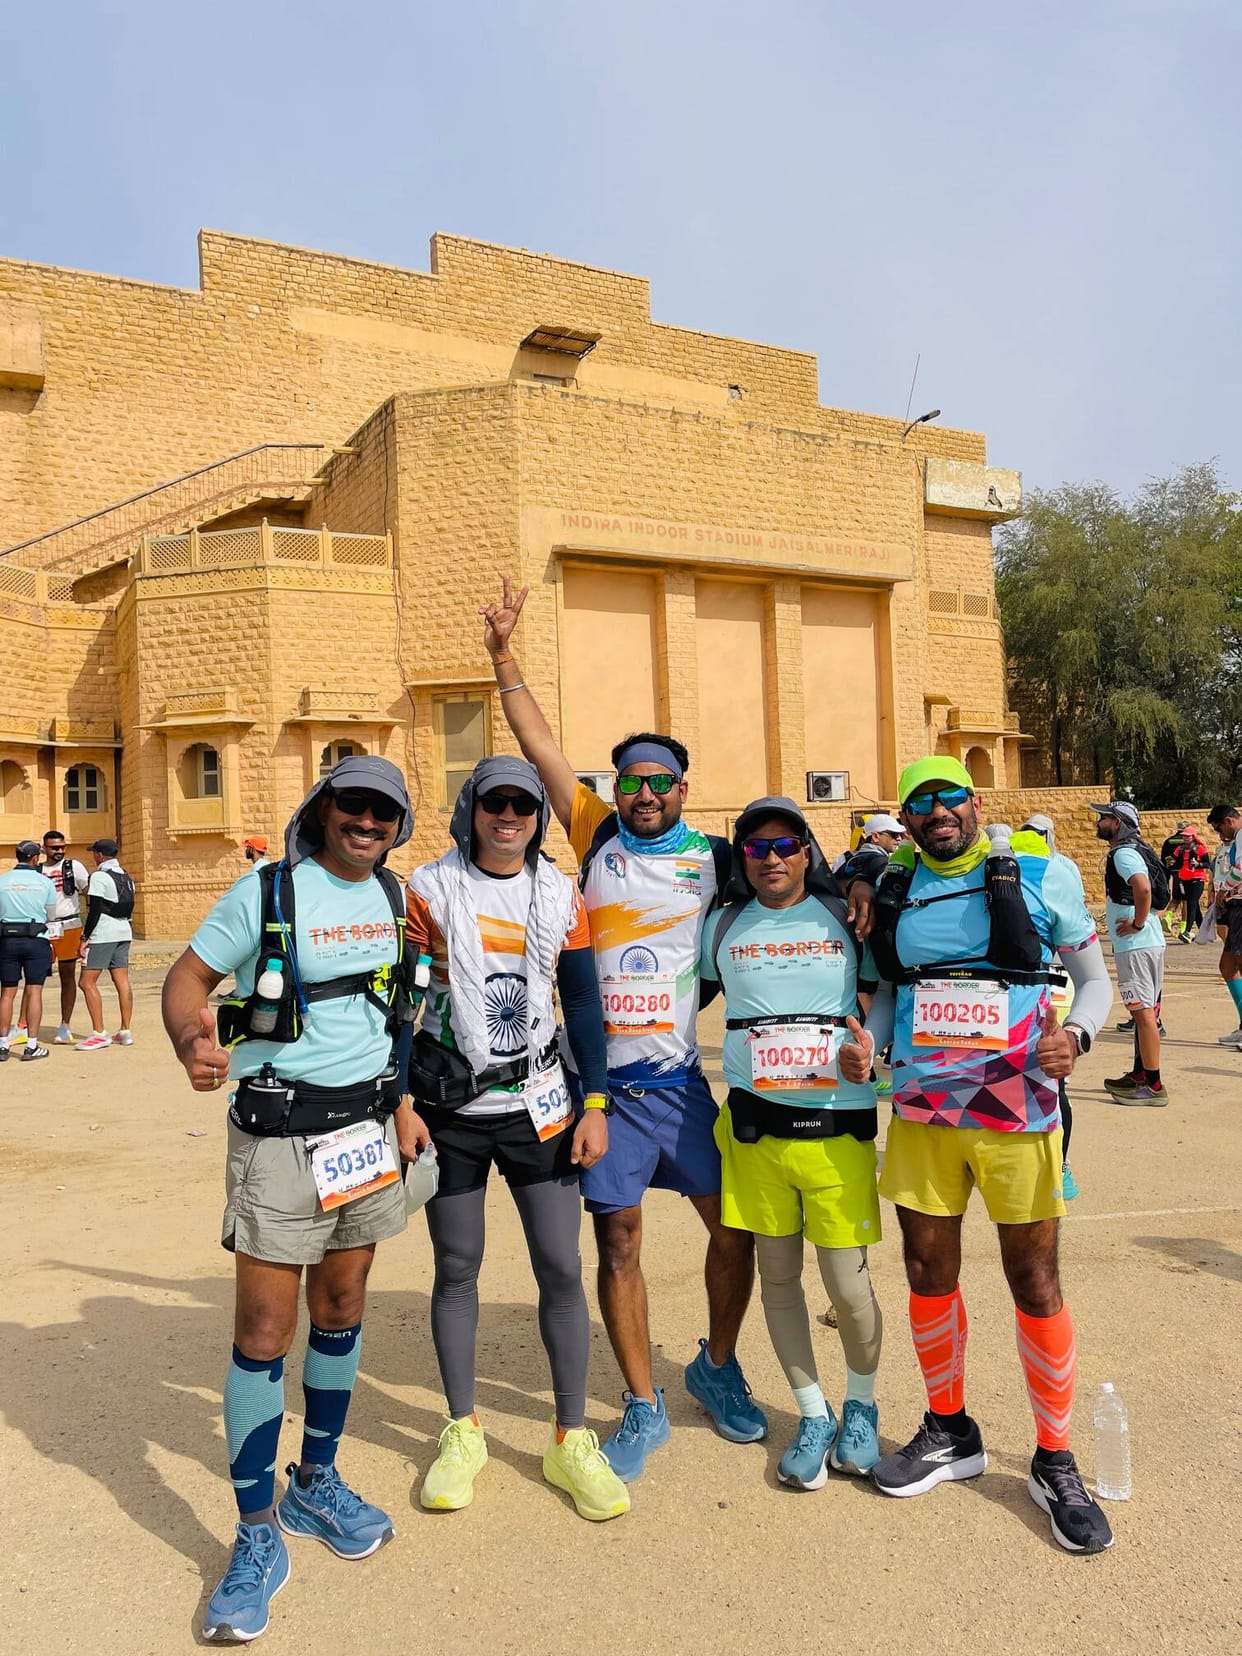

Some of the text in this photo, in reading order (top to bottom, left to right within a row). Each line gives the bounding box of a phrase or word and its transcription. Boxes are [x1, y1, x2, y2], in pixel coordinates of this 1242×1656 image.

[561, 514, 623, 532] INDIRA
[629, 522, 688, 540] INDOOR
[695, 528, 763, 547] STADIUM
[309, 925, 348, 945] THE
[729, 939, 844, 961] THE BORDER
[940, 981, 980, 989] THE BORDER
[603, 993, 671, 1013] 100280
[919, 1002, 1000, 1025] 100205
[757, 1046, 830, 1067] 100270
[792, 1120, 822, 1128] KIPRUN
[334, 1130, 347, 1140] THE
[322, 1138, 384, 1183] 50387
